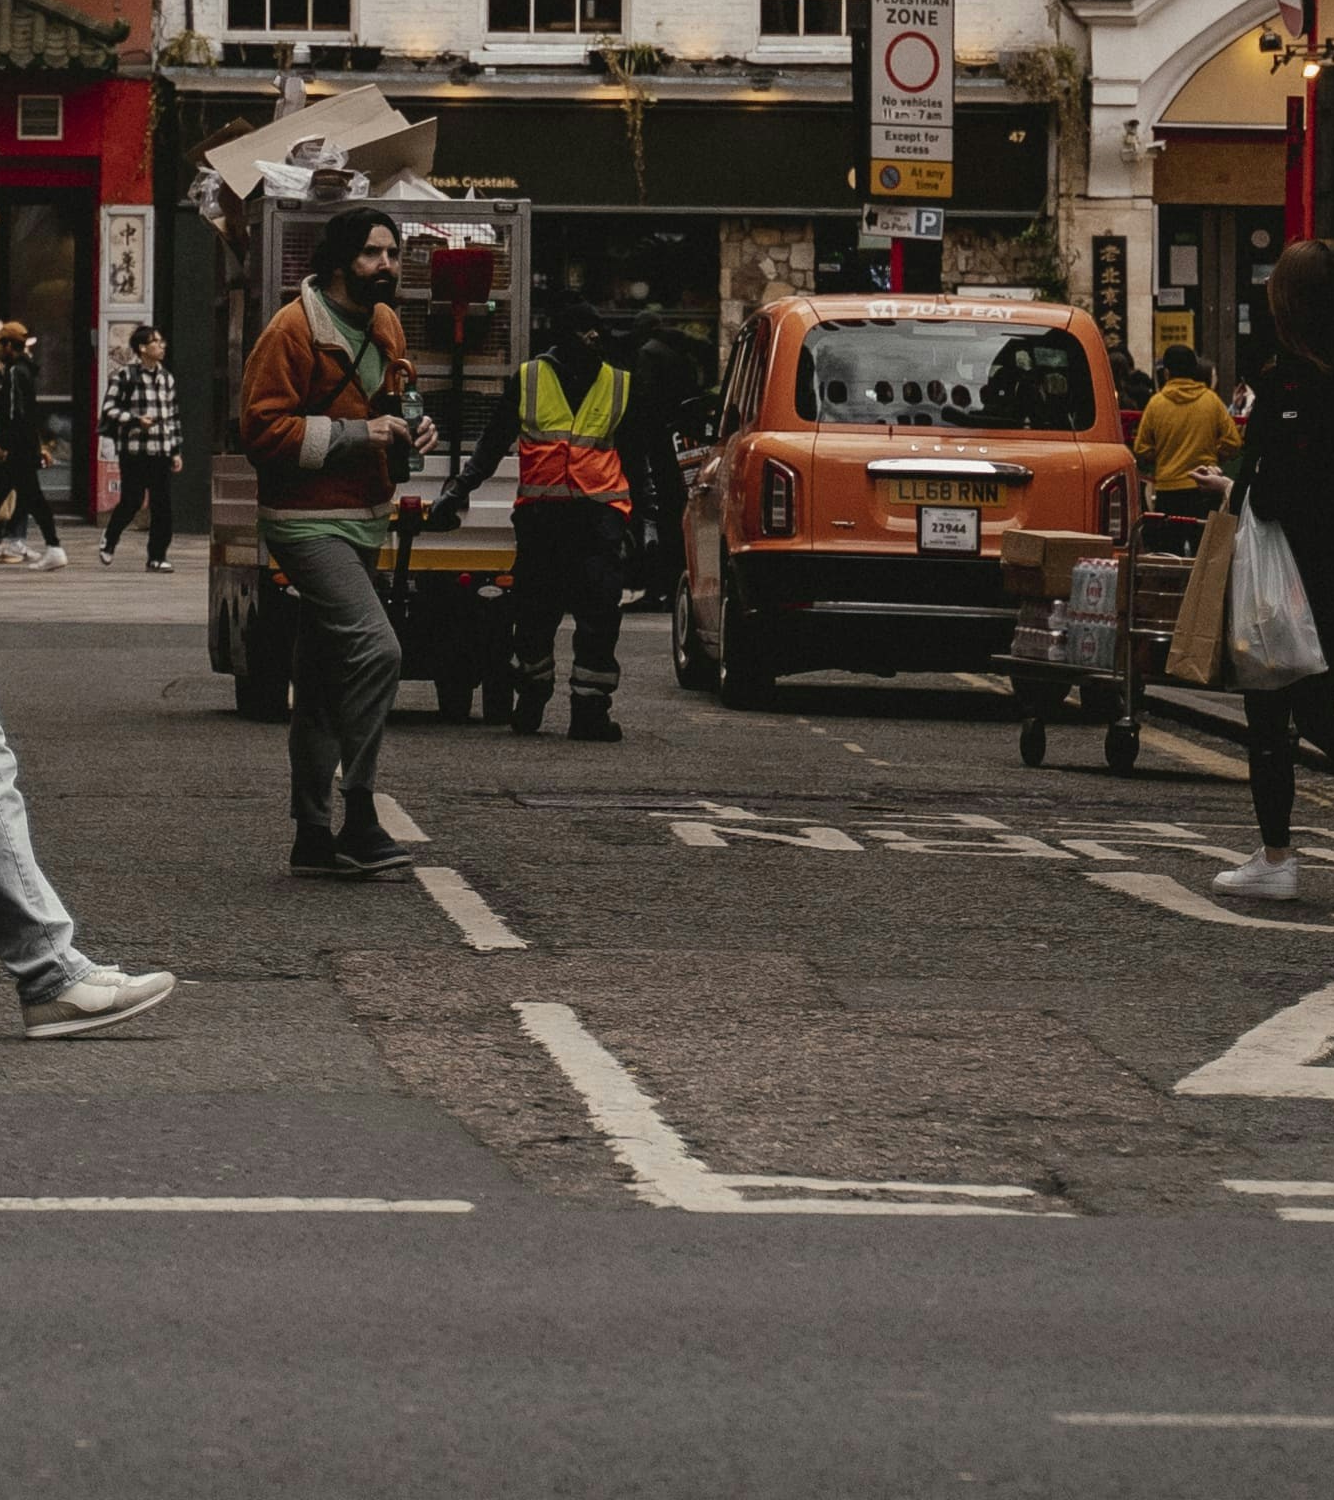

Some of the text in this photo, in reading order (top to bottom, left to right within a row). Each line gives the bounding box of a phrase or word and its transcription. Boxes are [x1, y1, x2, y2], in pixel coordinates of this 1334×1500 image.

[886, 8, 939, 26] ZONE
[882, 96, 943, 109] No vehicles
[885, 131, 940, 143] Except for
[1008, 130, 1027, 143] 47
[895, 145, 929, 155] access
[910, 168, 945, 181] At any
[915, 180, 940, 190] time
[920, 212, 937, 234] P
[907, 302, 1015, 320] JUST EAT
[898, 481, 999, 503] LL68 RNN
[931, 523, 967, 534] 22944
